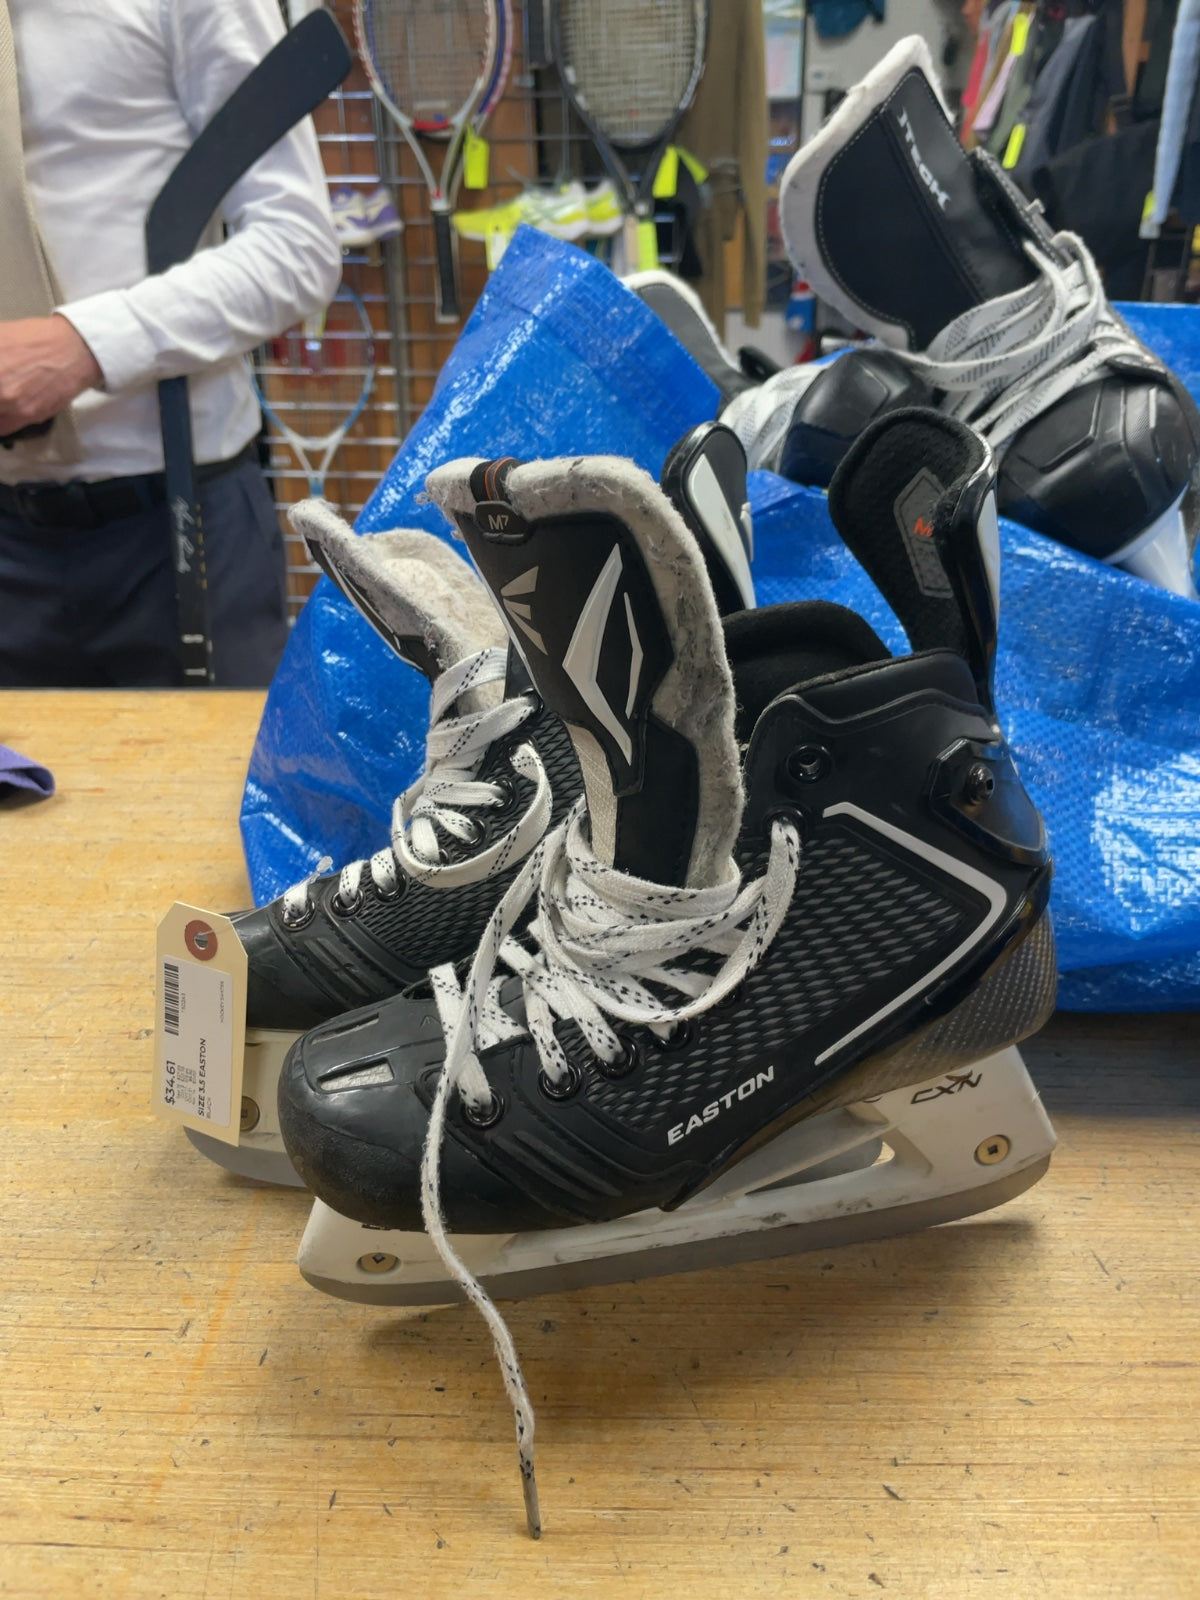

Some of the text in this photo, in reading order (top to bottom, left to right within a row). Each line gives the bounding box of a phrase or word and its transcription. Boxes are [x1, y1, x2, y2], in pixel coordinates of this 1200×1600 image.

[487, 514, 509, 530] M7
[164, 1060, 177, 1106] $34.61
[198, 1038, 207, 1117] SIZE 3.5 EASTON
[667, 1065, 774, 1146] EASTON
